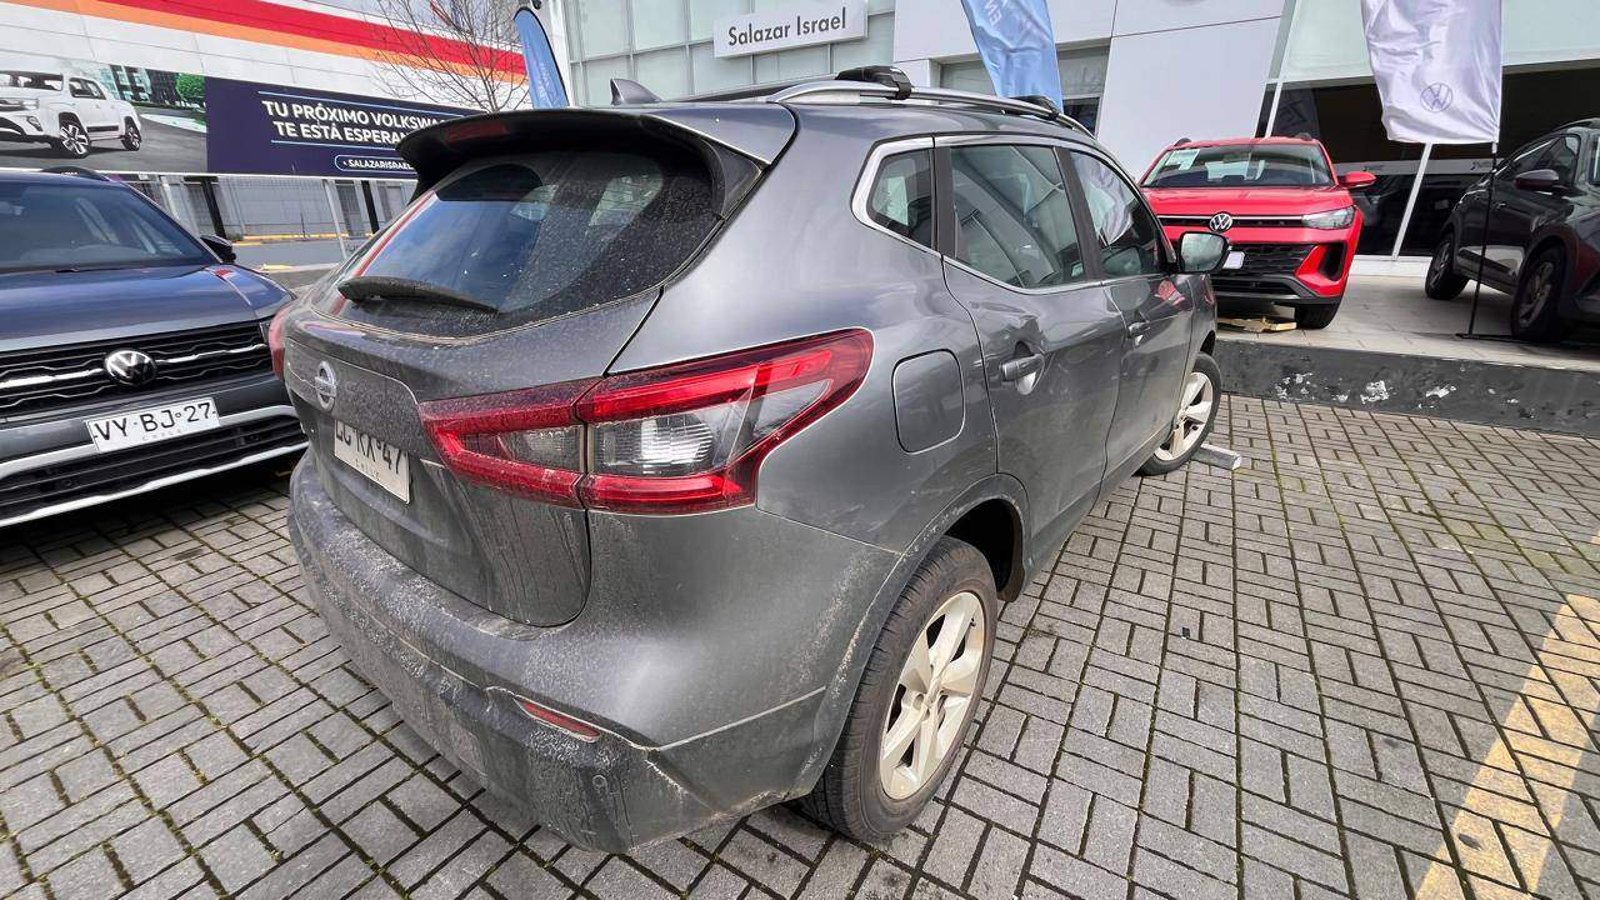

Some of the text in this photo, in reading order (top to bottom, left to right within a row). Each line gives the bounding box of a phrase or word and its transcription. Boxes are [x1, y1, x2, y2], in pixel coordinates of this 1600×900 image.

[728, 6, 846, 46] Salazar Israel
[262, 100, 288, 117] TU
[293, 103, 369, 125] PRÓXIMO
[273, 121, 298, 137] TE
[301, 123, 342, 141] ESTÁ
